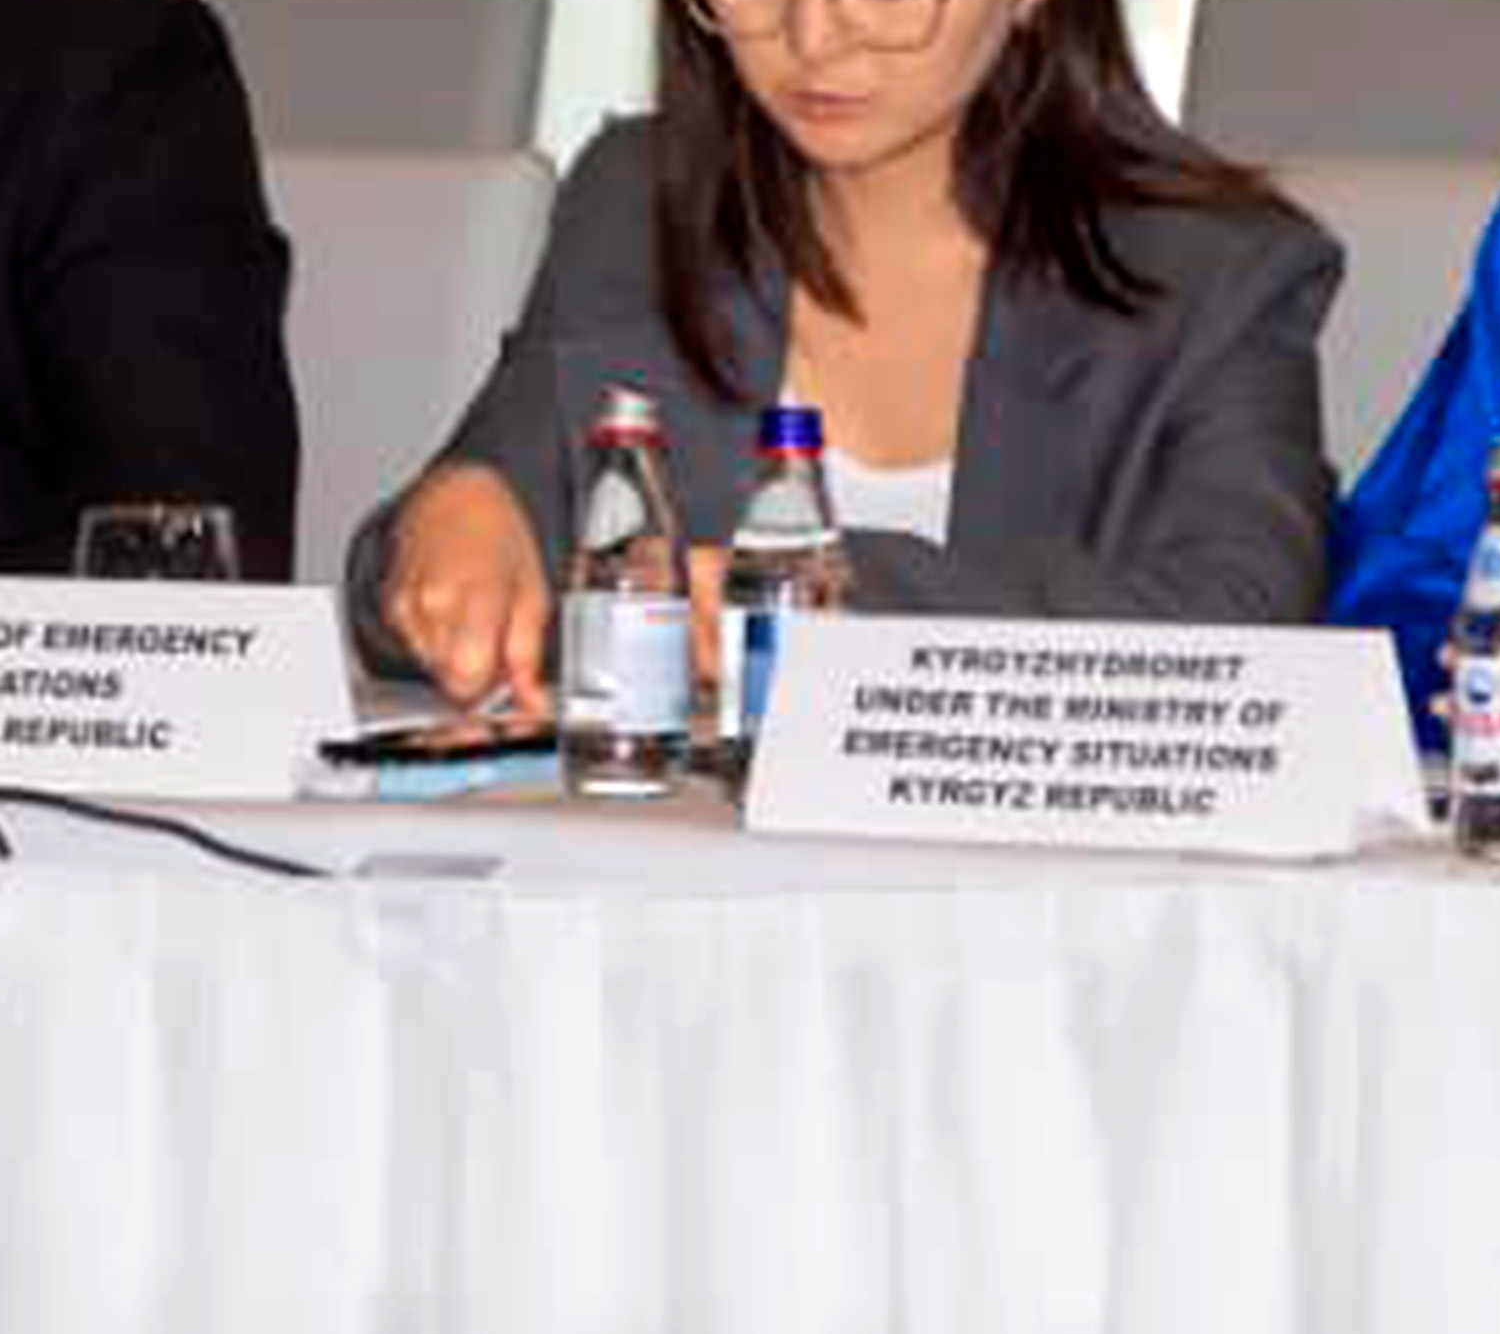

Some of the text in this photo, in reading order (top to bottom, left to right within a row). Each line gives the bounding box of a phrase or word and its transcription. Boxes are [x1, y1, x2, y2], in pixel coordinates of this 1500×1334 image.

[43, 624, 256, 657] EMERGENCY
[912, 646, 1247, 682] KYRGYZHYDROMET
[854, 685, 1285, 727] UNDER THE MINISTRY OF
[3, 716, 173, 751] REPUBLIC
[842, 728, 1279, 773] EMERGENCY SITUATIONS
[889, 775, 1218, 815] KYRGYZ REPUBLIC
